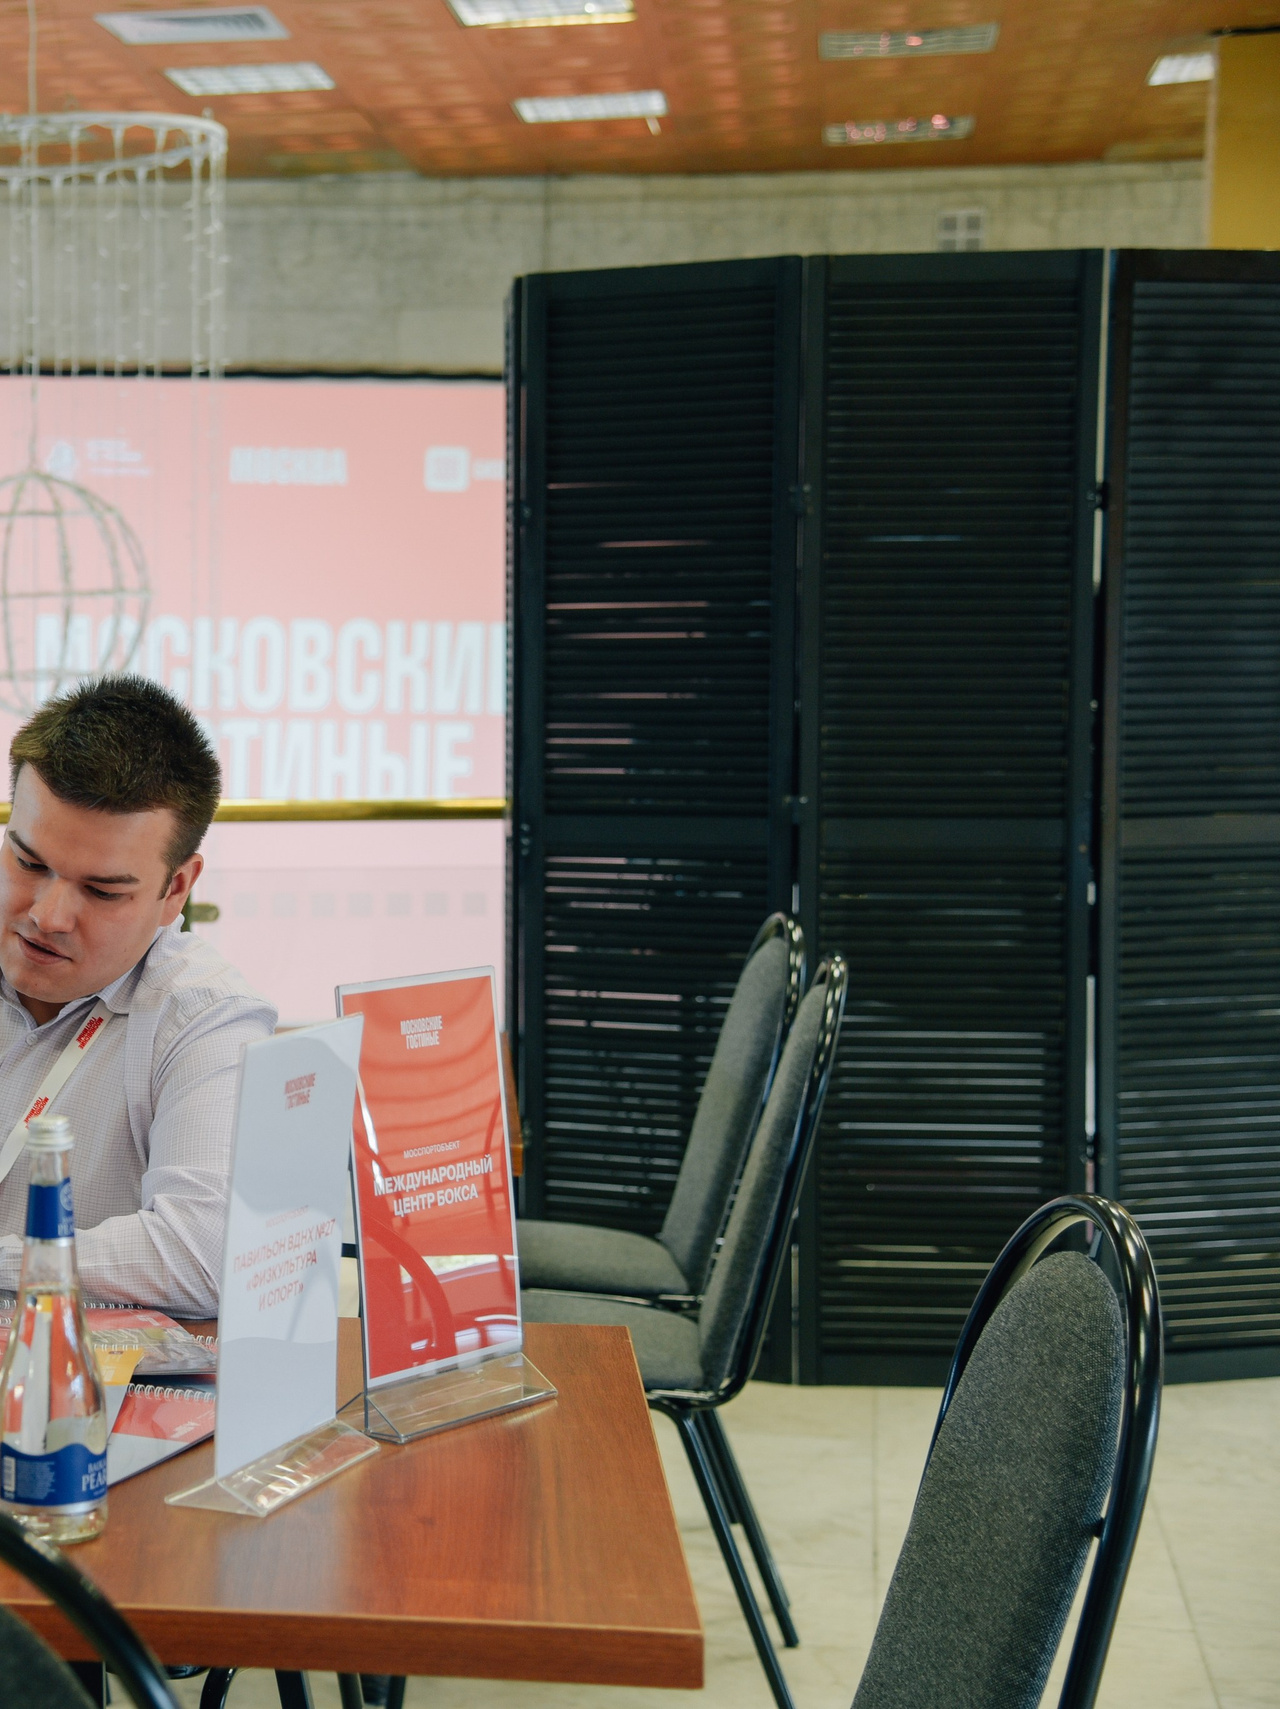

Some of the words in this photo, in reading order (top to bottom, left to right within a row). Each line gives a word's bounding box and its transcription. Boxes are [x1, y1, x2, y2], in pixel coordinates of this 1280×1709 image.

[206, 718, 474, 800] ТИНЫЕ
[403, 1140, 461, 1159] МОССПОРТОБЪЕКТ
[373, 1154, 493, 1196] МЕЖДУНАРОДНЫЙ
[393, 1192, 435, 1217] ЦЕНТР
[437, 1183, 479, 1207] БОКСА
[233, 1237, 286, 1275] ПАВИЛЬОН
[288, 1225, 314, 1252] ВДНХ
[258, 1294, 266, 1312] И
